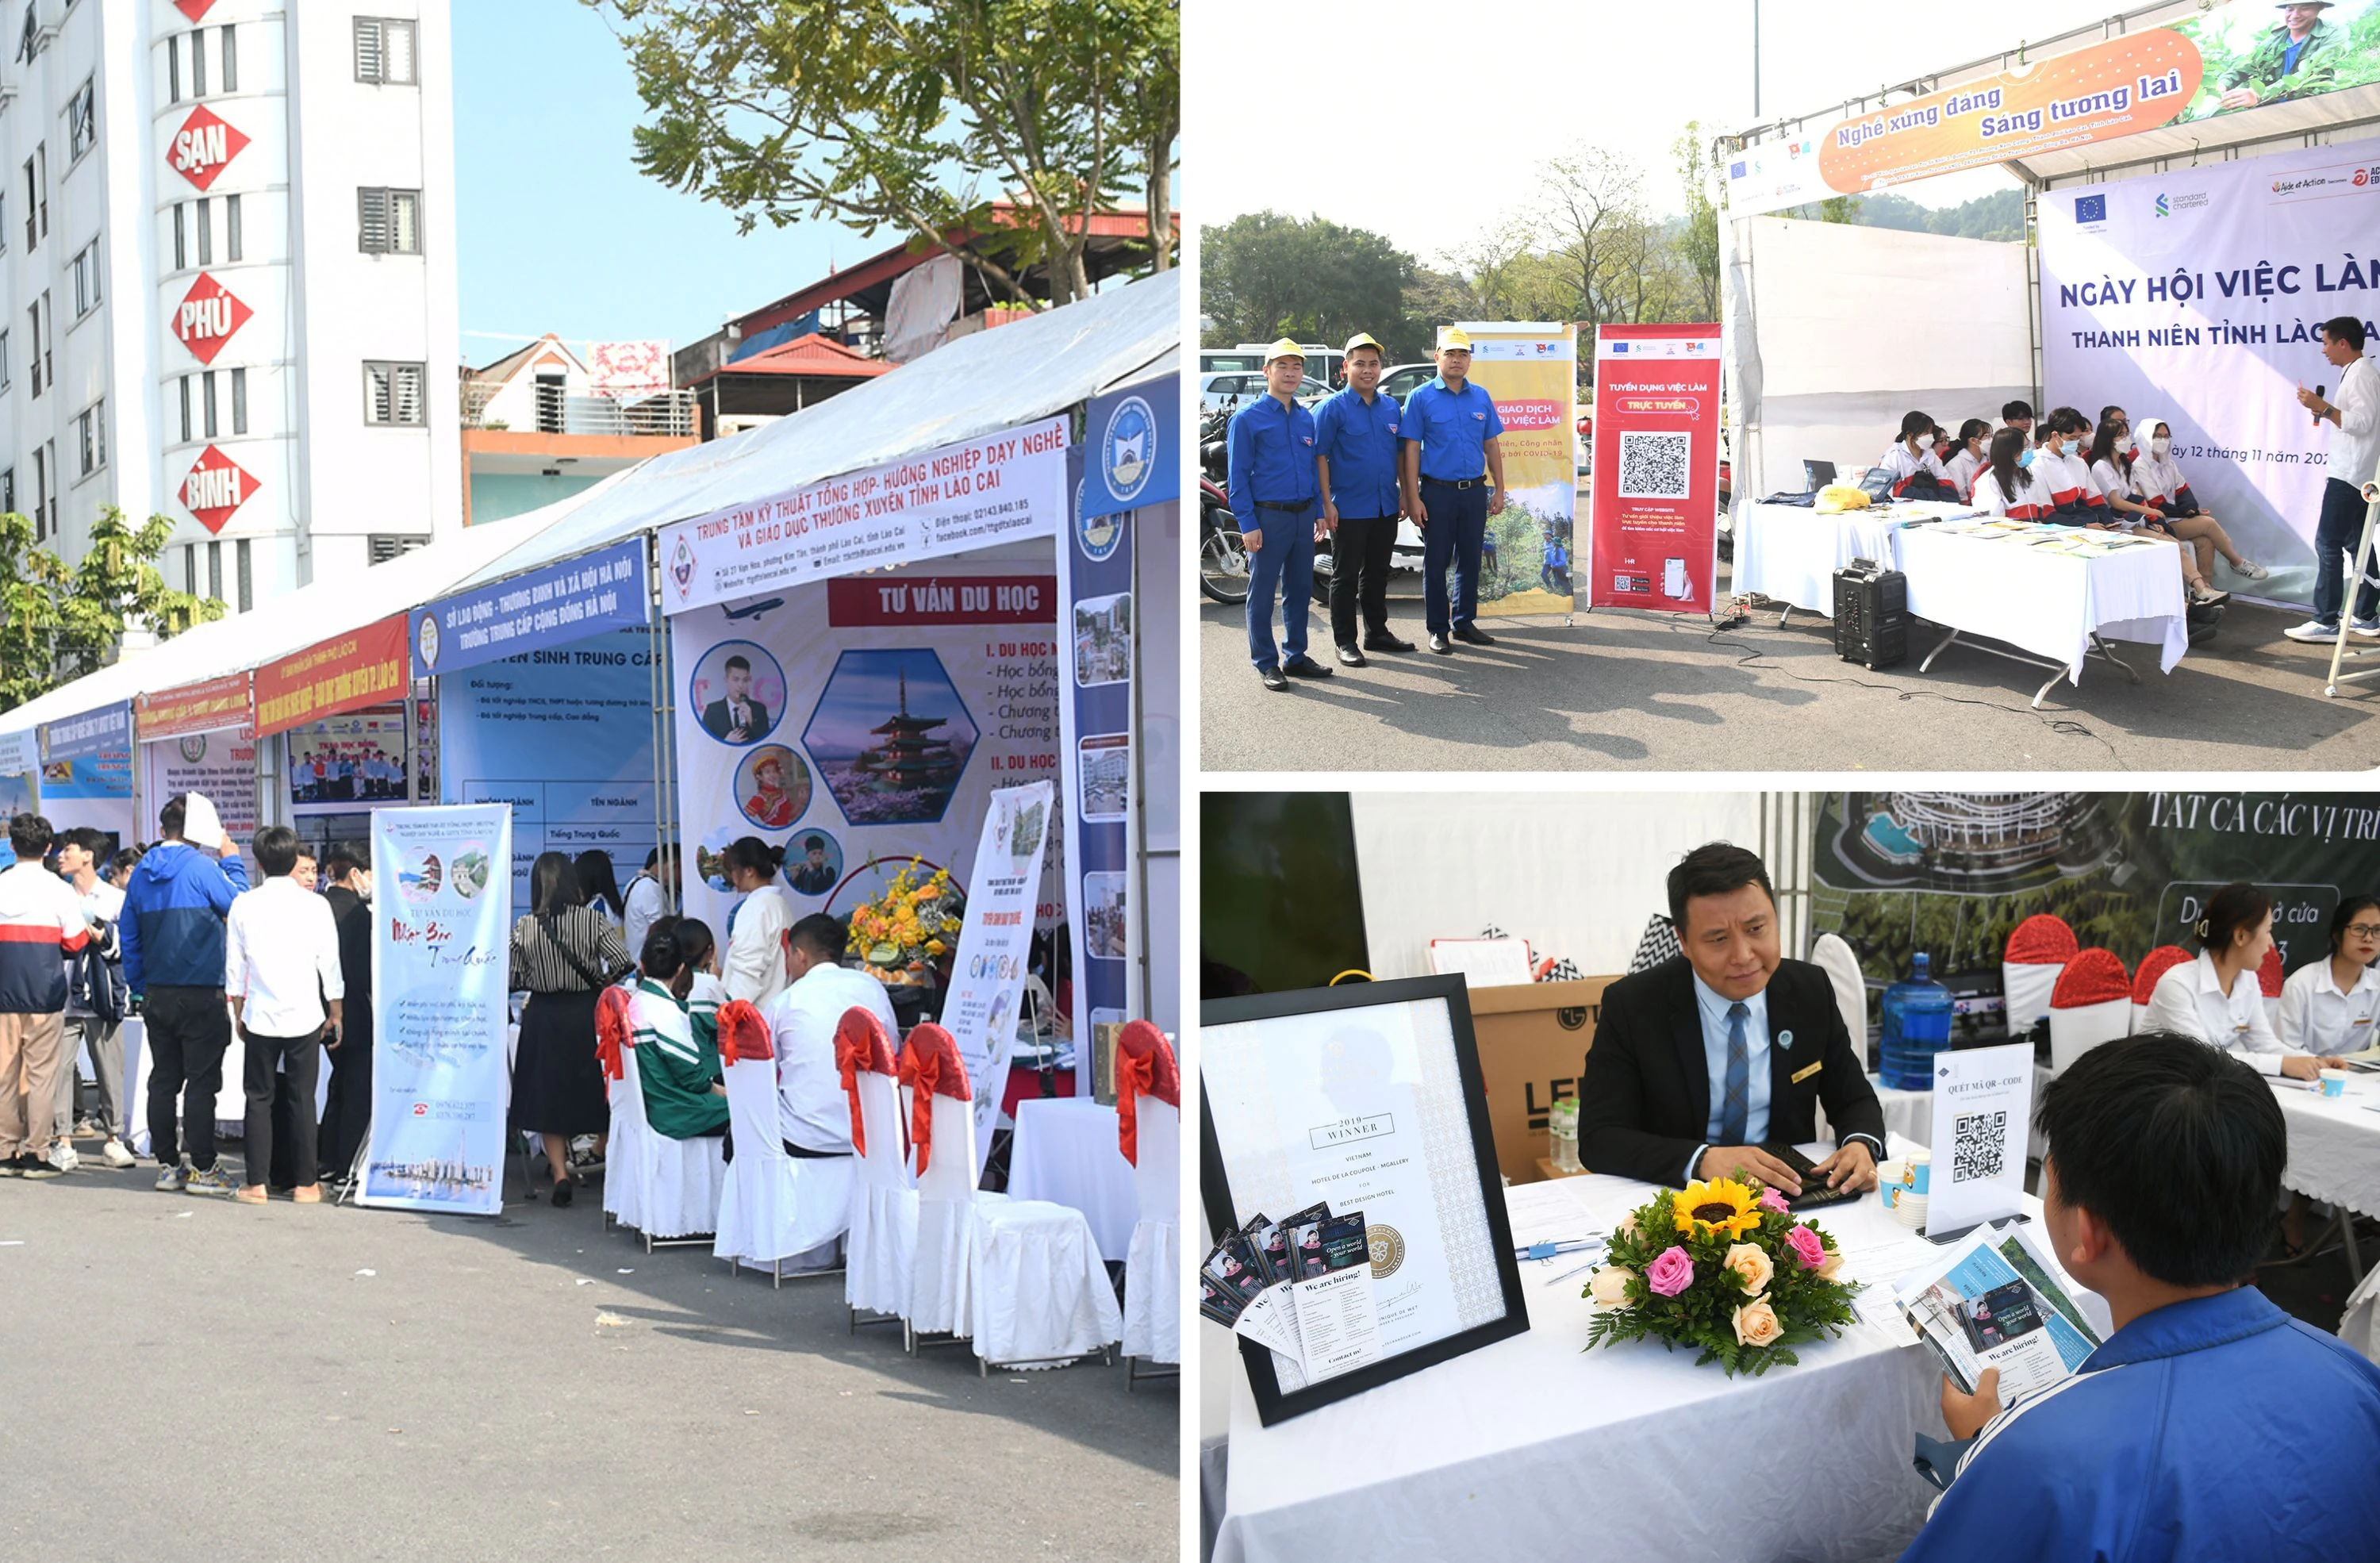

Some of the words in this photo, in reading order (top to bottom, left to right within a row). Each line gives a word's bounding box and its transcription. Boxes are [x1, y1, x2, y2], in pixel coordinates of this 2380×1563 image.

[1981, 110, 2040, 136] Sáng
[2052, 86, 2128, 120] tương
[2140, 71, 2178, 100] lai
[1837, 116, 1883, 147] Nghề
[1889, 104, 1938, 133] xứng
[1945, 86, 2001, 116] đáng
[175, 124, 227, 174] SẠN
[2281, 181, 2294, 191] Aide
[2303, 178, 2326, 189] Action
[2173, 192, 2206, 203] standard
[2173, 200, 2209, 210] chartered
[2061, 275, 2136, 308] NGÀY
[2148, 267, 2204, 308] HỘI
[2216, 260, 2301, 303] VIỆC
[2316, 253, 2380, 292] LÀ
[181, 288, 232, 341] PHÚ
[2071, 330, 2140, 348] THANH
[2148, 323, 2199, 347] NIÊN
[2209, 319, 2266, 345] TỈNH
[1640, 384, 1664, 393] DỤNG
[1667, 382, 1686, 393] VIỆC
[1688, 382, 1707, 391] LÀM
[1526, 405, 1552, 415] DỊCH
[1513, 415, 1536, 426] VIỆC
[1538, 414, 1560, 424] LÀM
[2171, 444, 2187, 459] ày
[2191, 446, 2202, 457] 12
[2207, 447, 2248, 463] tháng
[2252, 449, 2262, 461] 11
[2266, 450, 2298, 463] năm
[2304, 452, 2328, 465] 202
[186, 461, 240, 511] BÌNH
[697, 520, 729, 541] TRUNG
[775, 490, 812, 517] THUẬT
[816, 481, 848, 508] TỔNG
[884, 462, 927, 490] HƯỚNG
[931, 447, 981, 479] NGHIỆP
[986, 440, 1017, 467] DẠY
[1022, 421, 1064, 456] NGHỀ
[737, 530, 753, 550] VÀ
[755, 523, 781, 547] GIÁO
[785, 519, 809, 542] DỤC
[812, 503, 860, 532] THƯỜNG
[865, 491, 904, 519] XUYÊN
[908, 481, 939, 507] TỈNH
[944, 474, 971, 500] LÀO
[976, 469, 1001, 492] CAI
[447, 610, 457, 629] SỞ
[457, 607, 472, 626] LAO
[473, 600, 493, 624] ĐỘNG
[499, 587, 531, 614] THƯƠNG
[532, 582, 553, 605] BINH
[555, 577, 566, 599] VÀ
[567, 573, 581, 594] XÃ
[582, 566, 597, 592] HỘI
[599, 560, 613, 586] HÀ
[615, 556, 632, 583] NỘI
[878, 584, 908, 613] TƯ
[912, 578, 954, 613] VẤN
[961, 586, 990, 613] DU
[996, 586, 1039, 616] HỌC
[460, 624, 489, 651] TRƯỜNG
[489, 621, 516, 643] TRUNG
[516, 612, 532, 636] CẤP
[535, 608, 558, 634] CỘNG
[585, 594, 598, 618] HÀ
[600, 589, 617, 616] NỘI
[534, 651, 570, 665] SINH
[575, 651, 626, 666] TRUNG
[986, 644, 995, 657] I.
[999, 643, 1016, 657] DU
[1021, 642, 1047, 659] HỌC
[996, 664, 1023, 680] Học
[997, 684, 1023, 701] Học
[998, 705, 1050, 722] Chương
[999, 724, 1051, 743] Chương
[992, 757, 1004, 770] II.
[1008, 755, 1025, 770] DU
[1031, 755, 1055, 770] HỌC
[591, 797, 605, 806] TÊN
[607, 797, 637, 806] NGÀNH
[2254, 793, 2306, 836] CÁC
[2313, 805, 2337, 843] VỊ
[551, 829, 572, 840] Tiếng
[574, 830, 596, 839] Trung
[598, 828, 620, 839] Quốc
[2288, 901, 2319, 923] cửa
[1948, 1081, 1971, 1095] QUÉT
[1972, 1080, 1984, 1091] MÃ
[1985, 1079, 1997, 1090] QR
[2002, 1076, 2023, 1086] CODE
[1526, 1077, 1586, 1116] LE
[1339, 1116, 1361, 1127] 2019
[1328, 1123, 1378, 1140] WINNER
[1345, 1152, 1372, 1162] VIETNAM
[1311, 1176, 1330, 1185] HOTEL
[1349, 1166, 1376, 1177] COUPOLE
[1380, 1158, 1409, 1169] MGALLERY
[1339, 1199, 1353, 1208] BEST
[1354, 1193, 1376, 1204] DESIGN
[1376, 1189, 1395, 1199] HOTEL
[1334, 1250, 1346, 1259] your
[1347, 1245, 1363, 1254] world
[1346, 1238, 1362, 1247] world
[1305, 1283, 1318, 1292] We
[1319, 1280, 1332, 1288] are
[1334, 1270, 1361, 1284] hiring!
[1998, 1314, 2012, 1323] Open
[2015, 1304, 2029, 1315] world
[2006, 1318, 2017, 1327] your
[2017, 1311, 2032, 1320] world
[1988, 1352, 2001, 1361] We
[2002, 1347, 2013, 1357] are
[2013, 1335, 2040, 1351] hiring!
[1328, 1352, 1351, 1364] Contact
